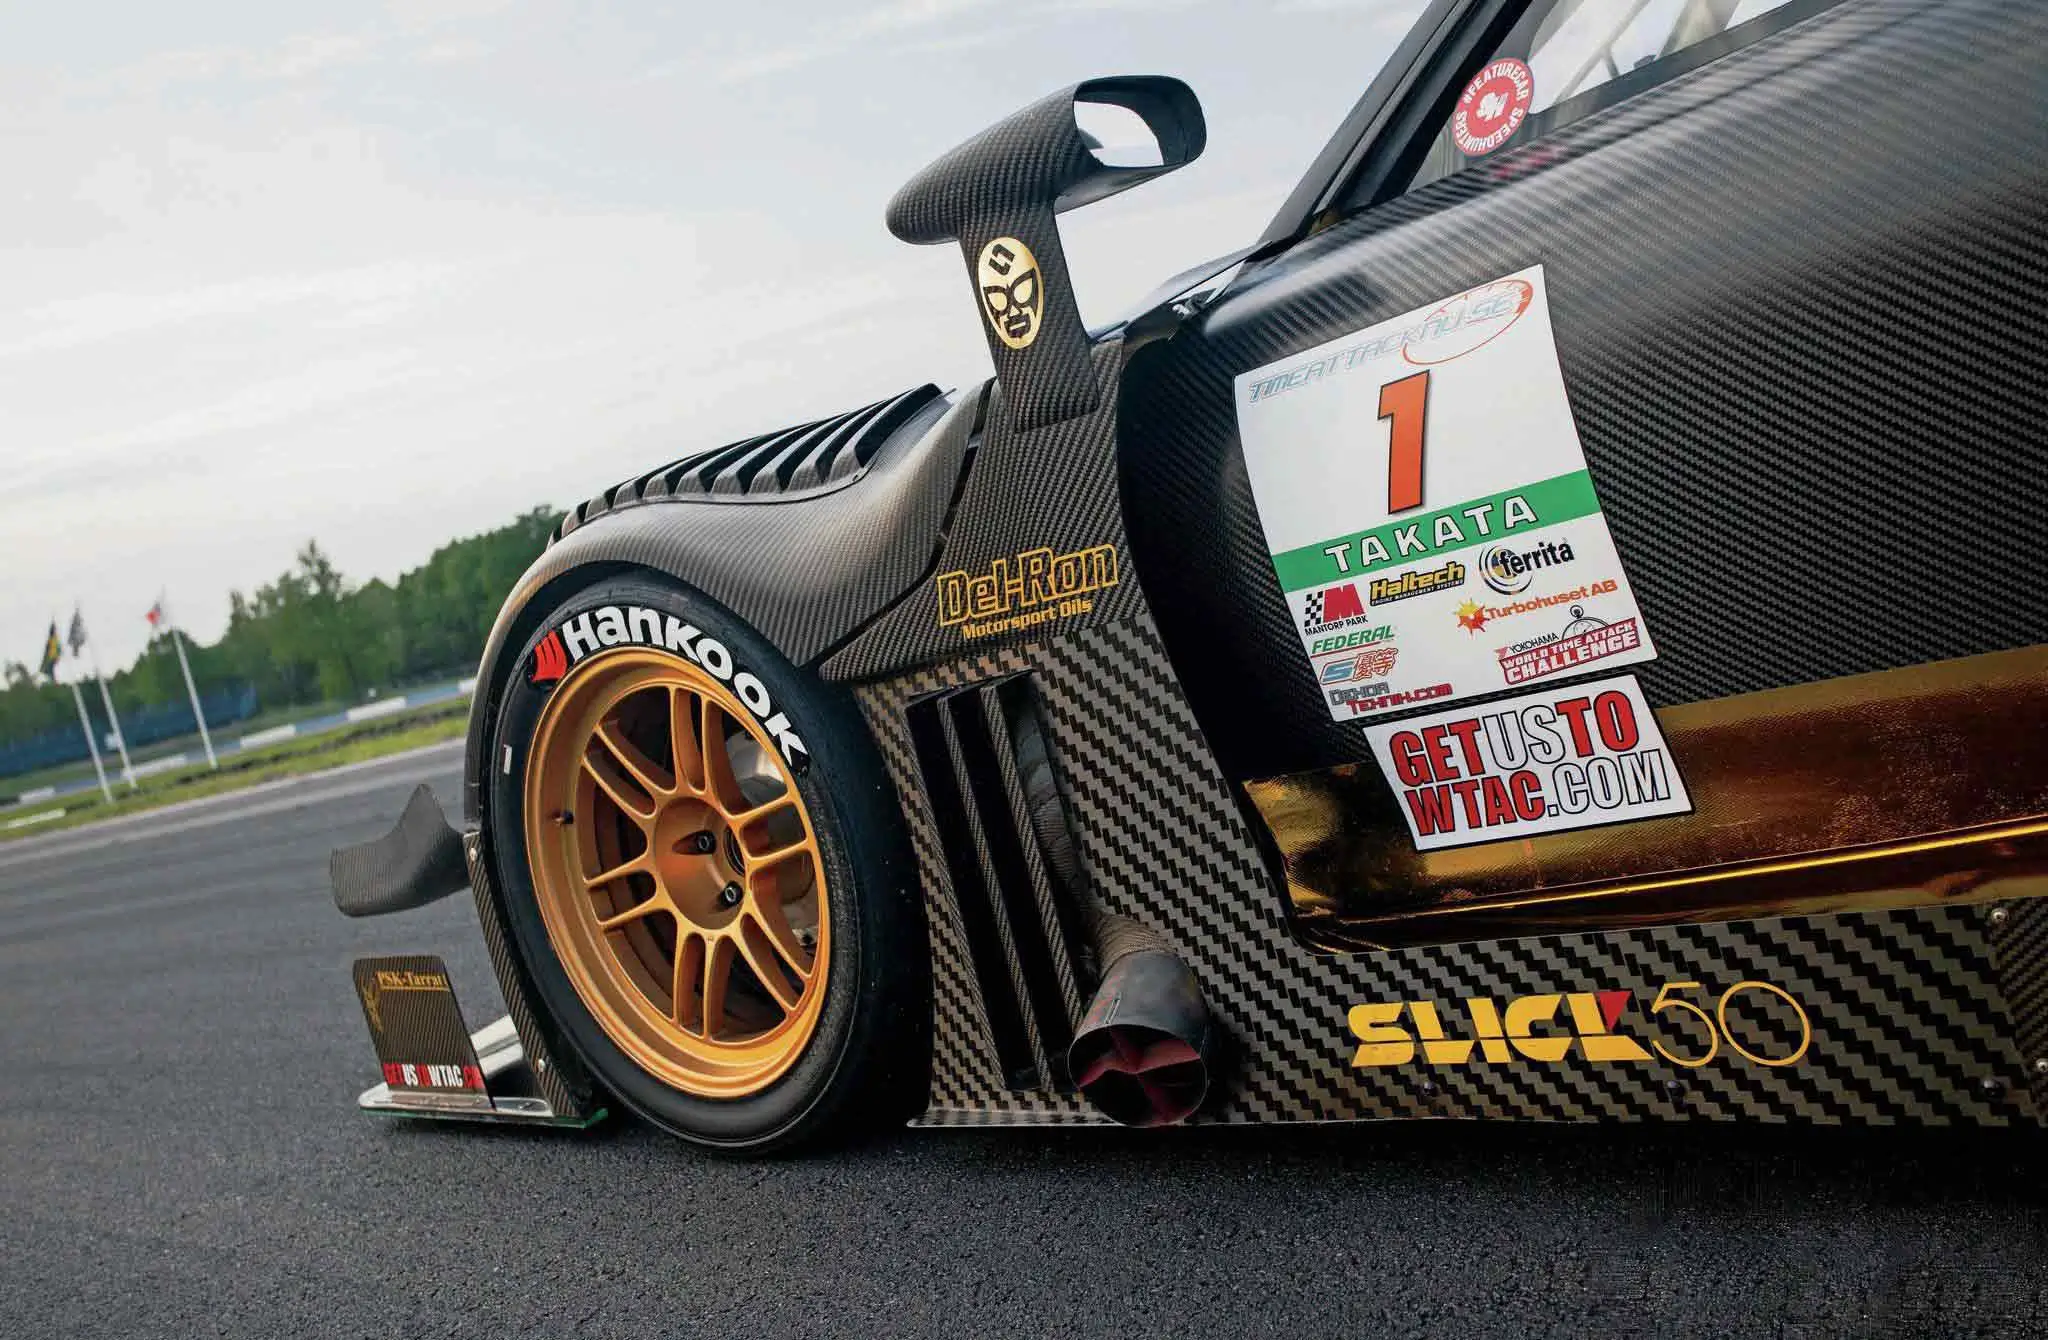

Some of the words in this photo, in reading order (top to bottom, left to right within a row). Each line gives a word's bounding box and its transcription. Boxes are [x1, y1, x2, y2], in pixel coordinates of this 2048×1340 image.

[1456, 107, 1523, 152] SPEEDHUNTERS
[1377, 369, 1430, 514] 1
[1325, 495, 1538, 573] TAKATA
[1370, 561, 1465, 600] Haltech
[1499, 541, 1575, 577] ferrita
[937, 543, 1119, 627] Del-Ron
[1485, 586, 1590, 619] Turbohuset
[1591, 579, 1618, 596] AB
[962, 606, 1056, 640] Motorsport
[1059, 598, 1092, 619] Oils
[1305, 620, 1343, 636] MANTORP
[1344, 615, 1369, 628] PARK
[1311, 624, 1395, 654] FEDERAL
[1502, 648, 1549, 669] WORLD
[1551, 638, 1583, 654] TIME
[1585, 622, 1634, 644] ATTACK
[1506, 631, 1639, 682] CHALLENGE
[1510, 632, 1560, 653] YOKOHAMA
[562, 605, 809, 768] Hankook
[1403, 749, 1672, 837] WTAC.COM
